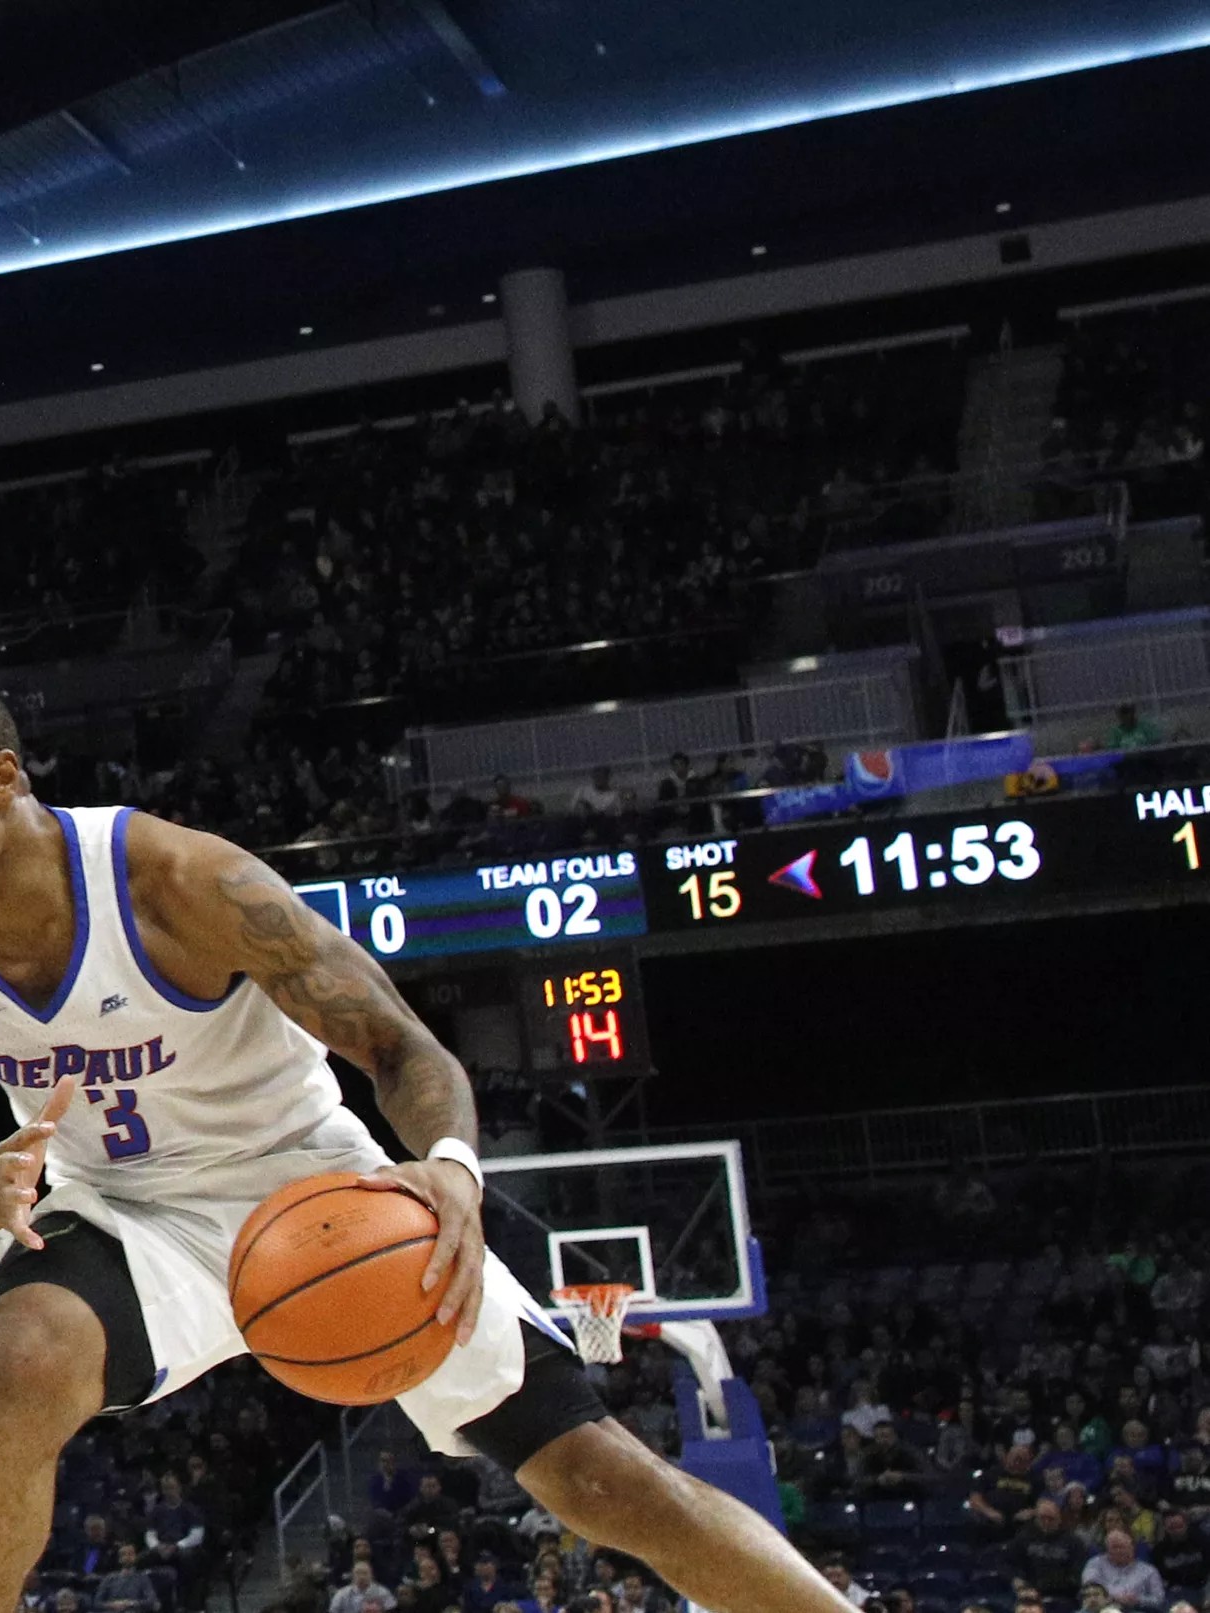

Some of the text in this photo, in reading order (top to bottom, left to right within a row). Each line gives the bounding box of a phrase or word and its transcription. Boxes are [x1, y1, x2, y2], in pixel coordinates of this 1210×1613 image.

[477, 852, 636, 890] TEAM FOULS
[666, 840, 737, 871] SHOT
[839, 820, 1041, 896] 11:53
[1172, 820, 1202, 871] 1
[360, 876, 406, 899] TOL
[525, 884, 602, 939] 02
[678, 871, 742, 920] 15
[370, 903, 406, 954] 0
[543, 969, 623, 1008] 11:53
[568, 1010, 624, 1063] 14
[85, 1089, 151, 1162] 3
